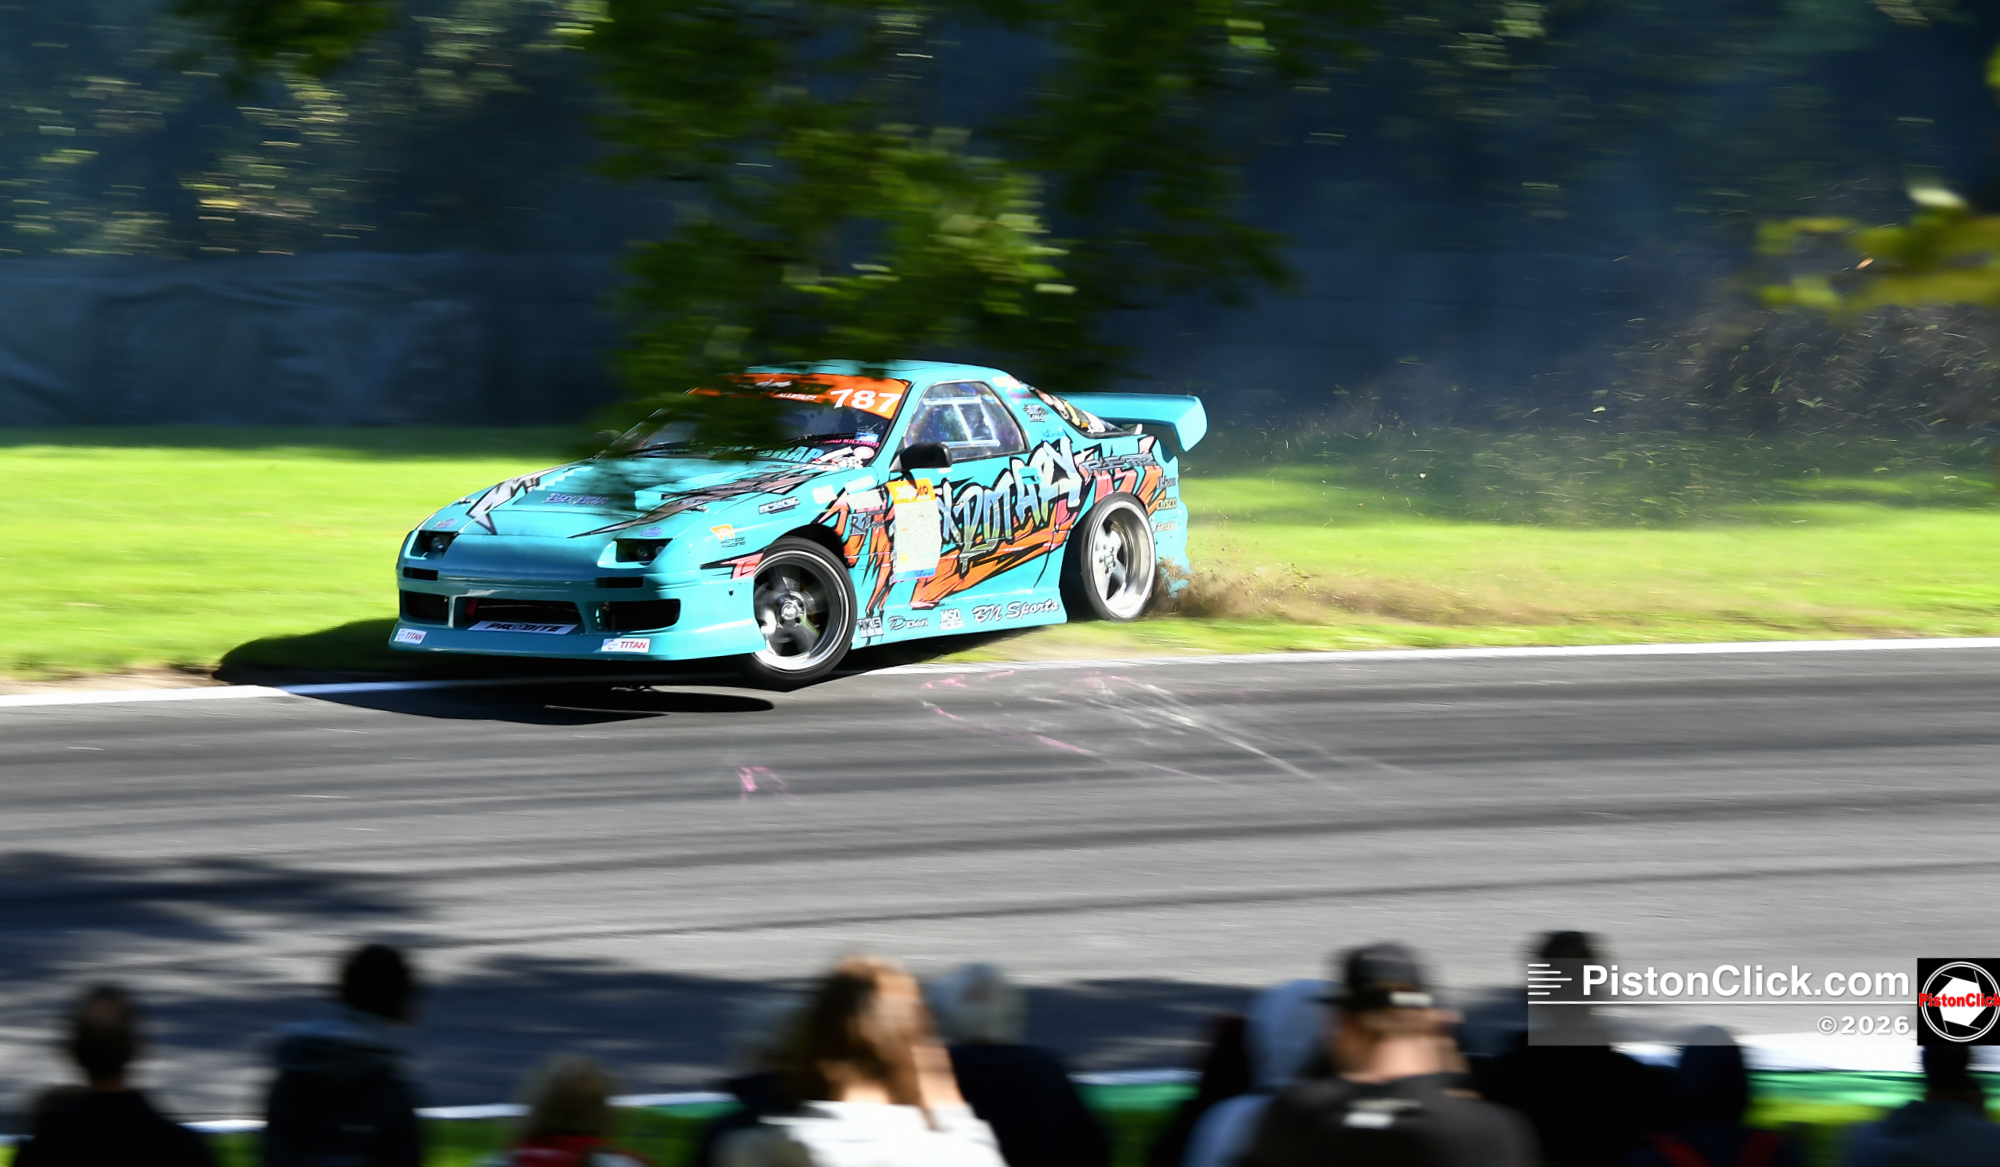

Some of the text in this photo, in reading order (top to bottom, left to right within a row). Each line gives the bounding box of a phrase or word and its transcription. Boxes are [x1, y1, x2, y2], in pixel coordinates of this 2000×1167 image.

[830, 388, 902, 412] 787
[972, 598, 1060, 622] BN Sports
[858, 618, 881, 630] HKS
[404, 632, 424, 641] TITAN
[620, 641, 647, 649] TITAN
